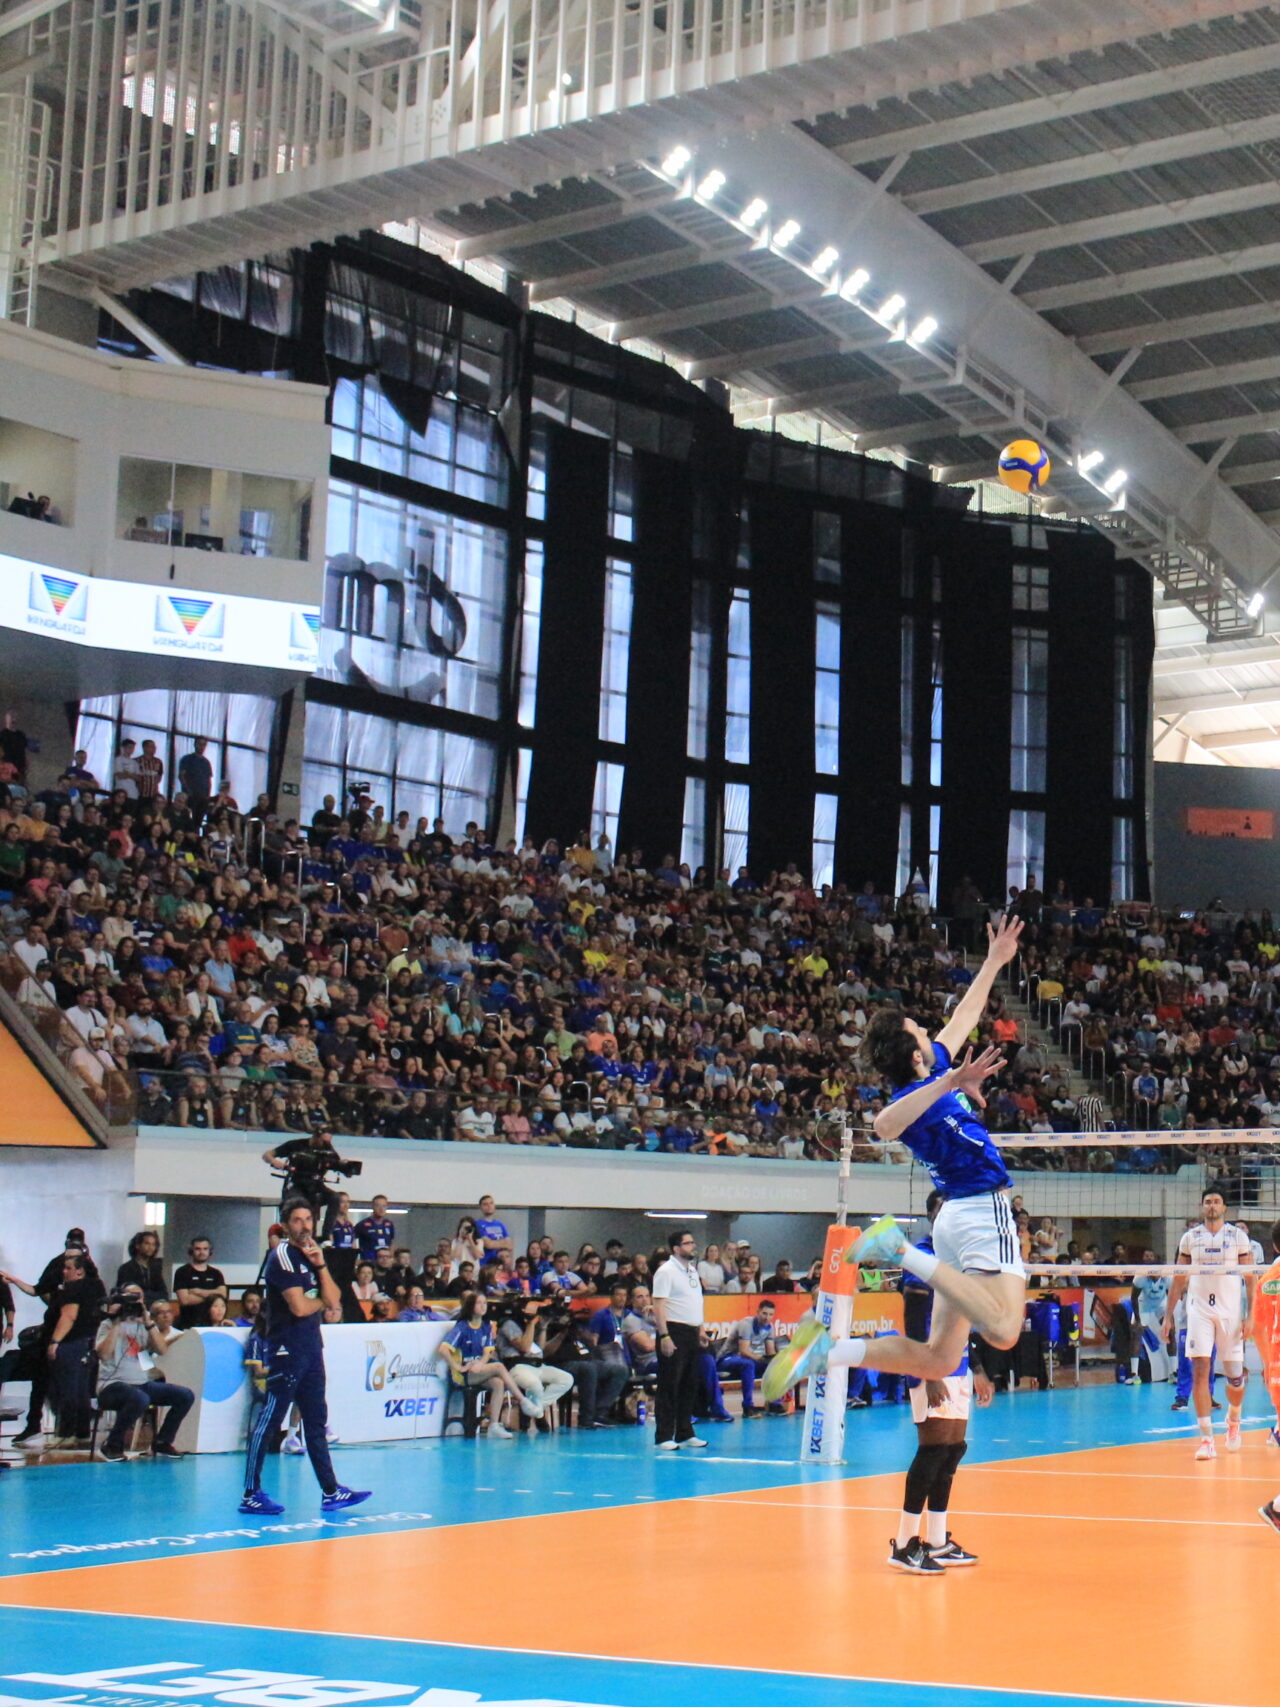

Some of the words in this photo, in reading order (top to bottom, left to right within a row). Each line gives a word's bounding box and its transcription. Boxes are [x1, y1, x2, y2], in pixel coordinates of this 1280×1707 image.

[829, 1246, 844, 1273] GOL
[822, 1294, 835, 1332] BET
[1208, 1293, 1217, 1307] 8
[815, 1372, 827, 1399] 1XB
[384, 1396, 439, 1418] 1XBET
[810, 1407, 825, 1455] 1XBET
